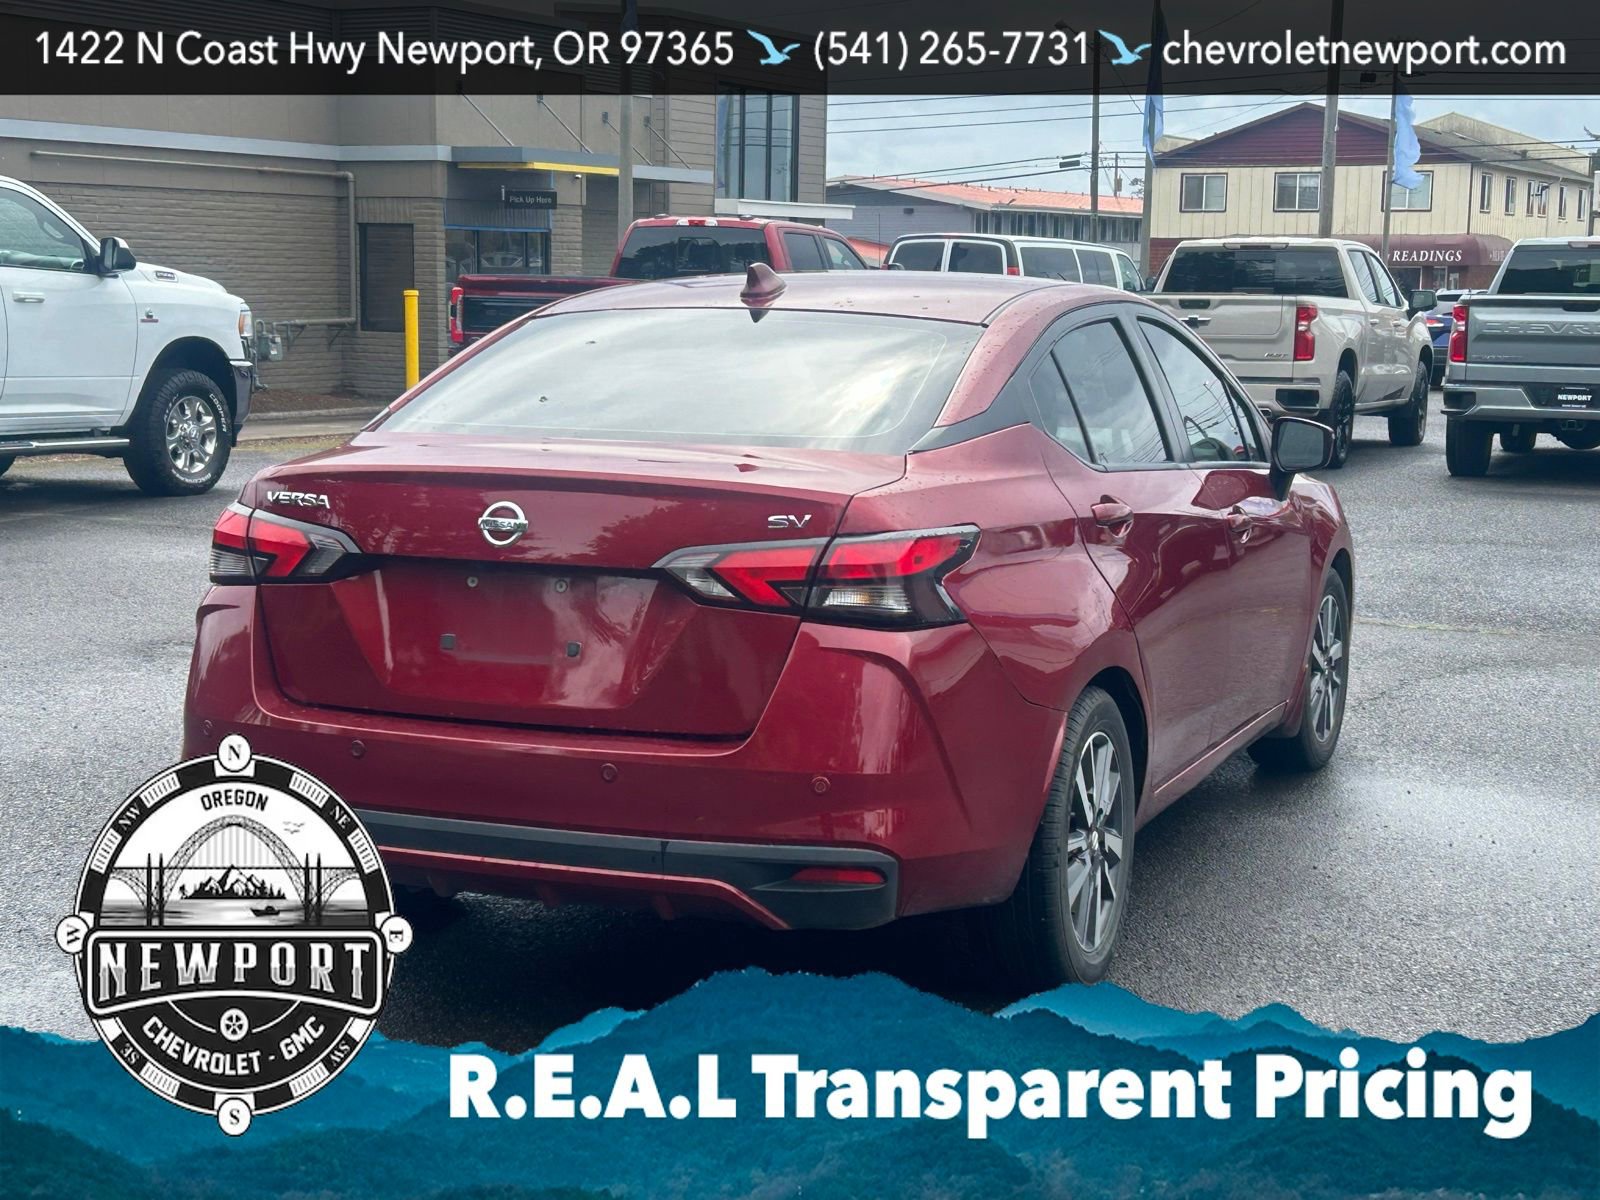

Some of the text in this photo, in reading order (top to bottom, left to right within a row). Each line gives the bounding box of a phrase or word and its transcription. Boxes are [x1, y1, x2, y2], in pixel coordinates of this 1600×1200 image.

[1392, 249, 1463, 262] READINGS
[1480, 321, 1600, 335] CHEVR
[1557, 393, 1593, 402] NEWPORT
[209, 393, 227, 433] COOPER
[266, 490, 331, 509] VERSA
[482, 518, 527, 532] NISSAN
[767, 514, 812, 529] SV
